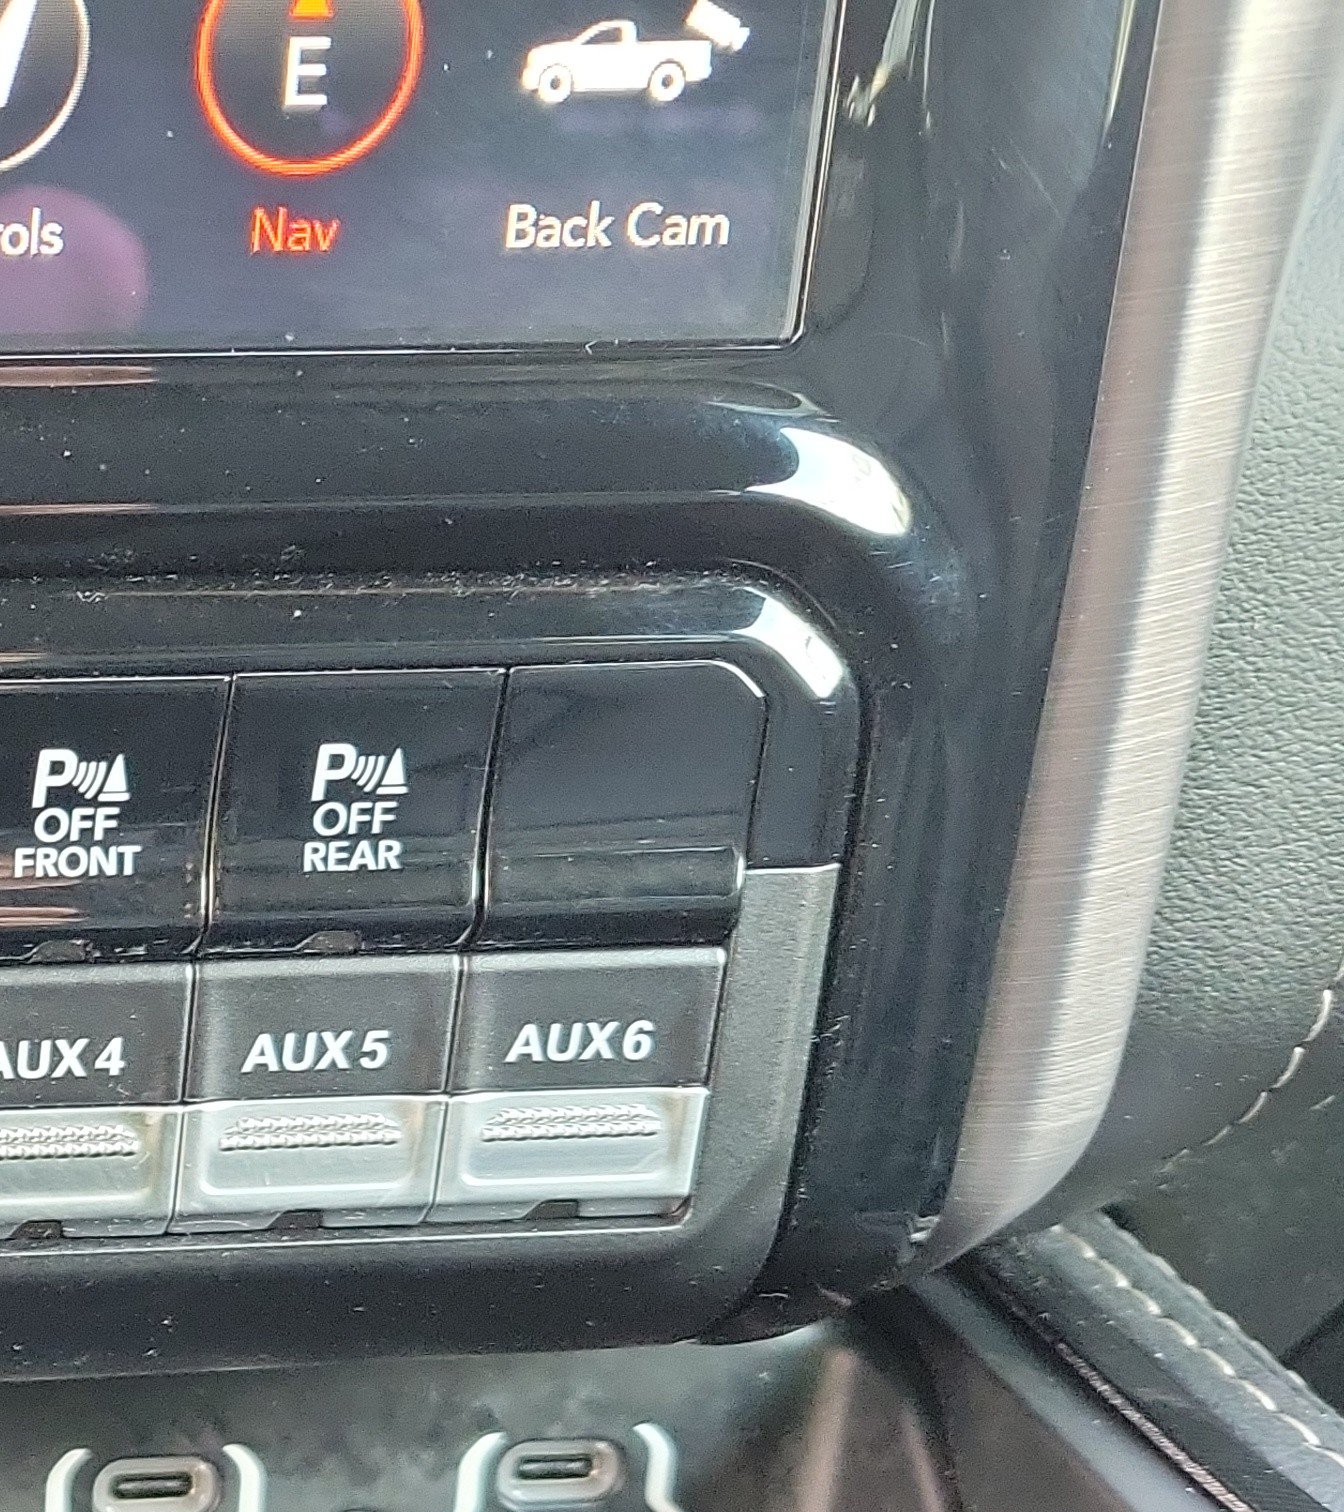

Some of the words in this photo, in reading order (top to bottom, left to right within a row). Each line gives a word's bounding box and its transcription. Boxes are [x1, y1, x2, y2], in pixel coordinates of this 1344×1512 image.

[284, 37, 331, 107] E
[250, 207, 341, 255] Nav
[506, 203, 612, 250] Back
[626, 204, 730, 248] Cam
[32, 806, 121, 842] OFF
[312, 801, 398, 836] OFF
[12, 845, 142, 878] FRONT
[302, 840, 402, 873] REAR
[94, 1037, 126, 1076] 4
[241, 1032, 358, 1074] AUX
[358, 1030, 390, 1069] 5
[503, 1022, 622, 1063] AUX
[621, 1020, 655, 1060] 6
